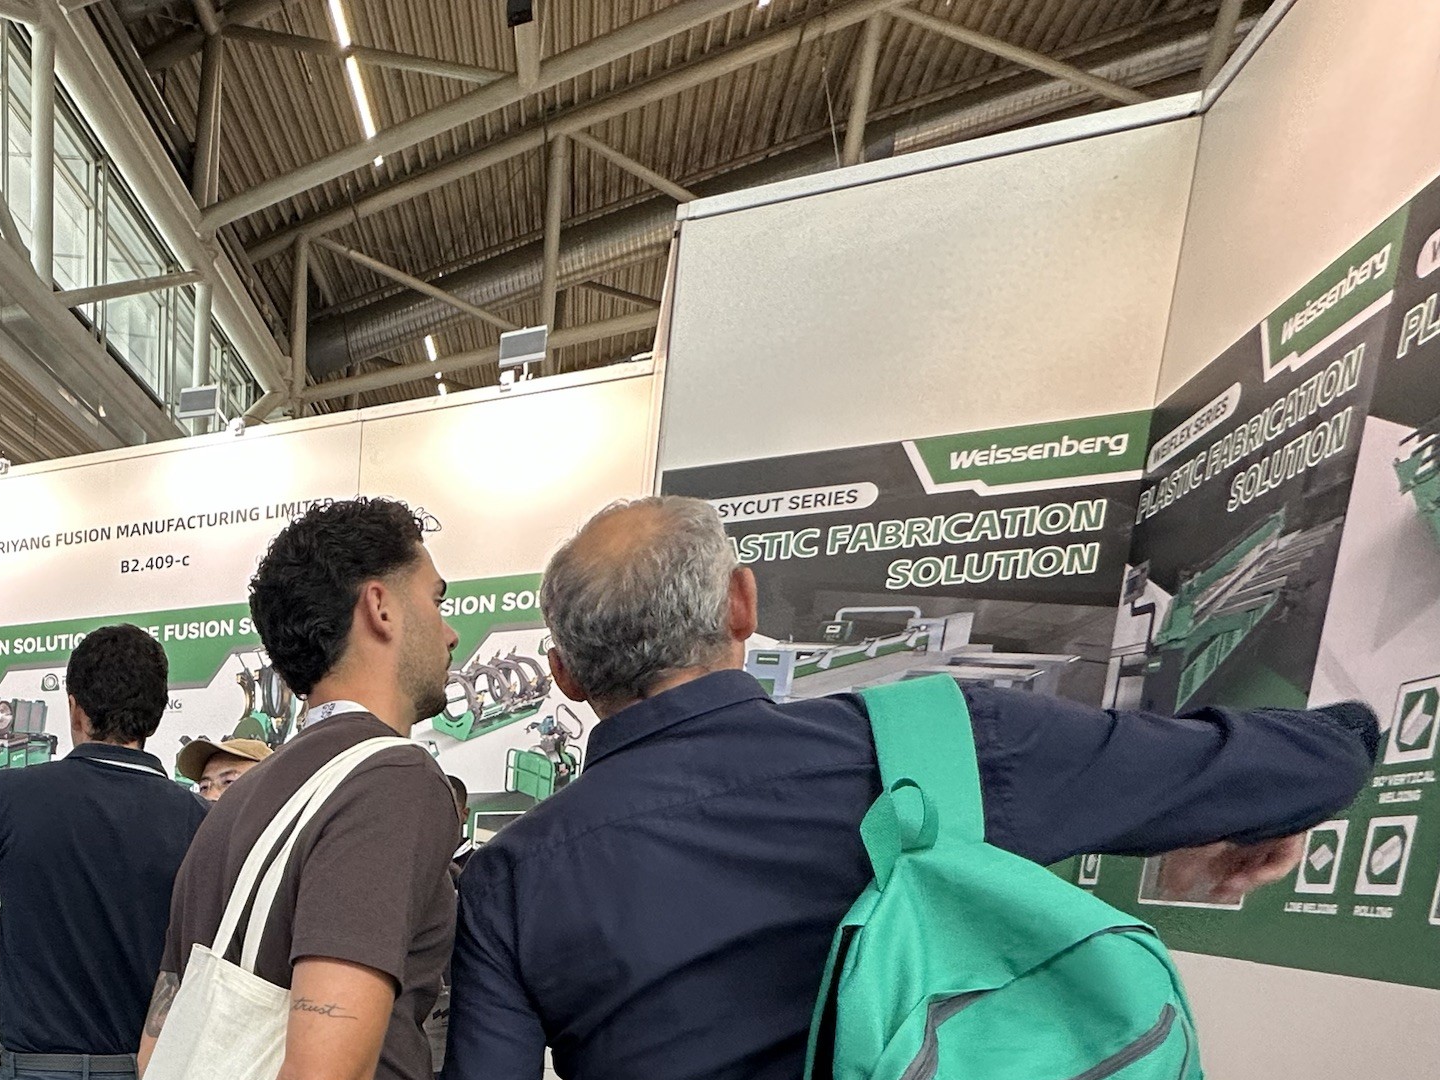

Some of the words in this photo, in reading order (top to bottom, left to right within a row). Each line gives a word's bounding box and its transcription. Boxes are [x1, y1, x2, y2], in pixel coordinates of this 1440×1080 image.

[1280, 242, 1392, 346] Weissenberg
[949, 433, 1129, 471] Weissenberg
[1135, 450, 1207, 526] PLASTIC
[1204, 341, 1366, 481] FABRICATION
[1227, 406, 1353, 513] SOLUTION
[718, 497, 785, 518] SYCUT
[787, 488, 859, 510] SERIES
[55, 527, 112, 548] FUSION
[116, 506, 260, 539] MANUFACTURING
[727, 528, 821, 564] STIC
[825, 498, 1108, 556] FABRICATION
[120, 553, 191, 574] B2.409-c
[885, 542, 1101, 590] SOLUTION
[439, 593, 497, 618] SION
[13, 632, 87, 655] SOLUTIO
[164, 618, 235, 642] FUSION
[292, 996, 359, 1020] trust
